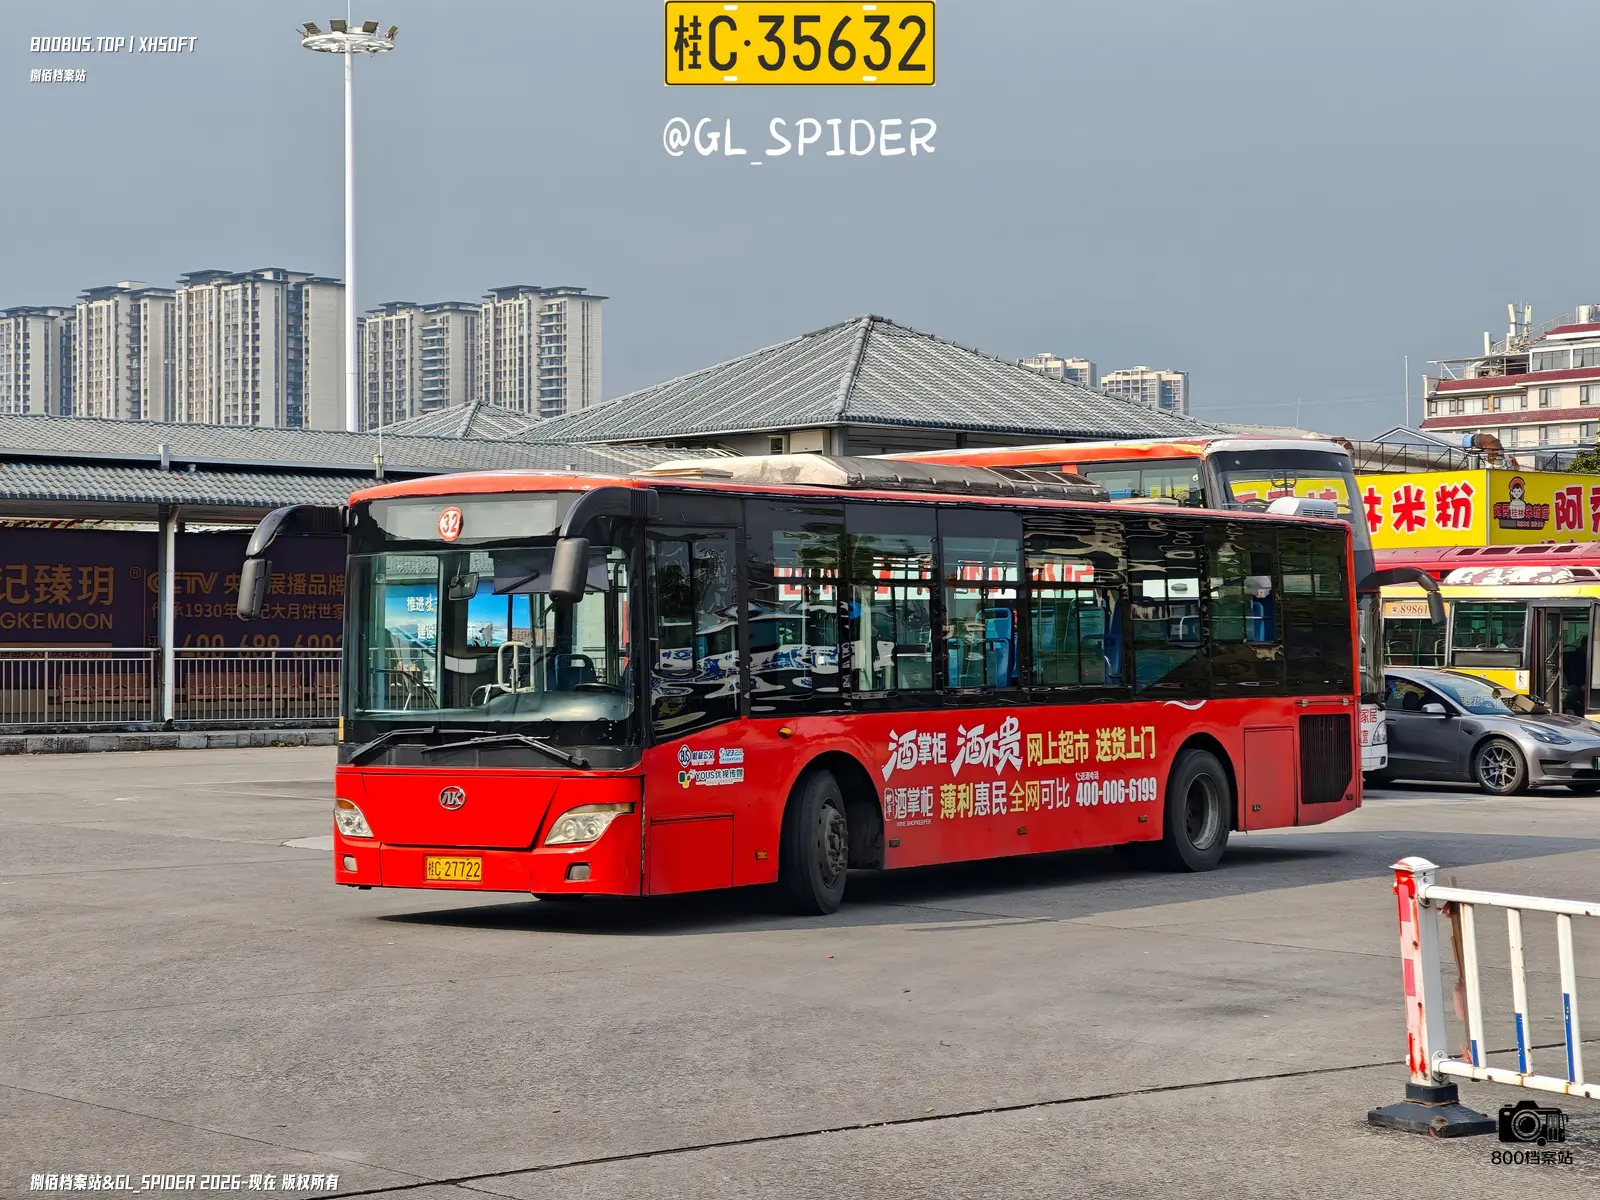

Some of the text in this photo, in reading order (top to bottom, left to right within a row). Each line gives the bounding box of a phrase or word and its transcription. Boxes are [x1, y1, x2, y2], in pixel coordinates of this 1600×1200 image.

[443, 513, 458, 533] 32
[224, 573, 344, 595] 央展播品牌
[881, 729, 947, 782] 酒掌柜
[1026, 730, 1089, 767] 网上超市
[1095, 726, 1156, 763] 送货上门
[895, 786, 934, 819] 酒掌柜
[1076, 777, 1157, 807] 400-006-6199
